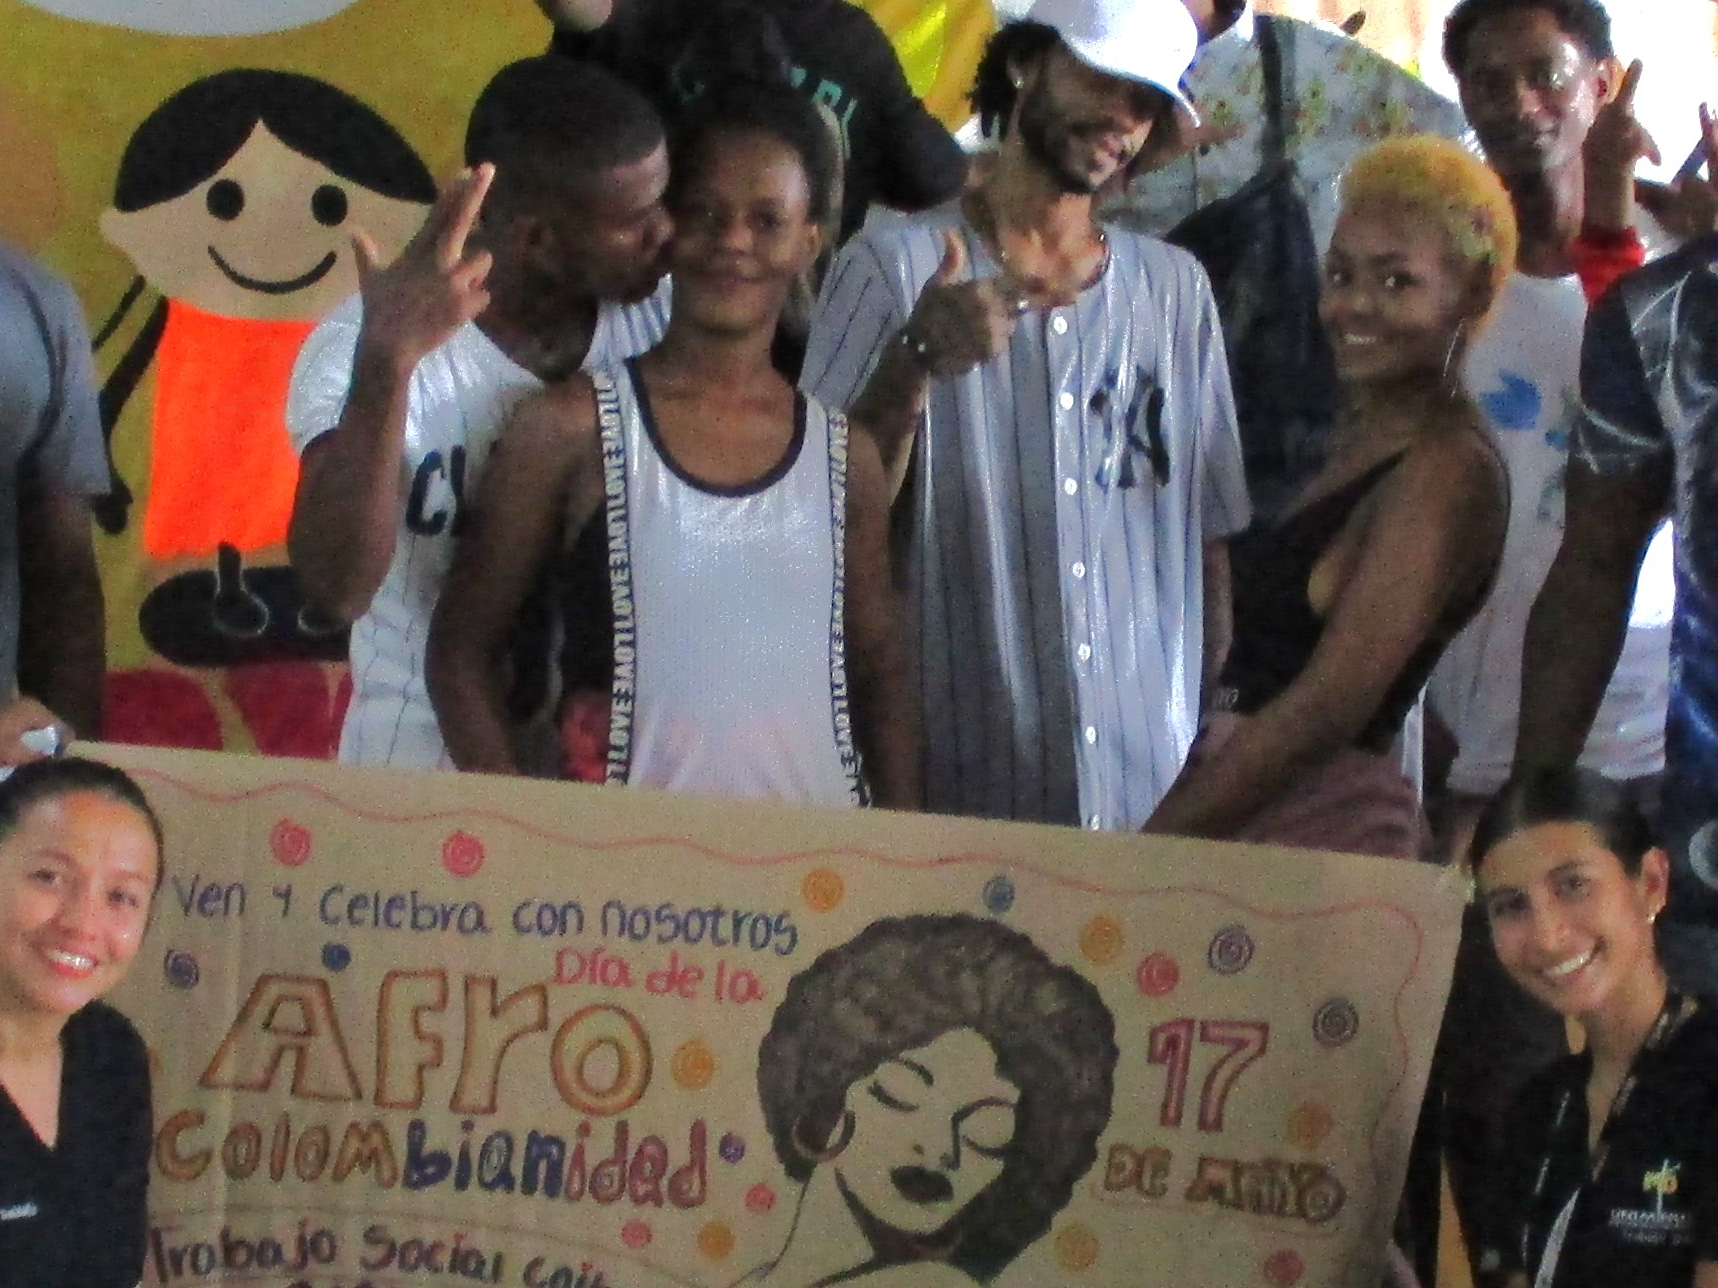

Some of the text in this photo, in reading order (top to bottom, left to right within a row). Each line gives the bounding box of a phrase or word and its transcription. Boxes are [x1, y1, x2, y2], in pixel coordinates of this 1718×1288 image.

[172, 873, 246, 917] Ven
[512, 898, 584, 938] con
[600, 899, 799, 956] nosotros
[645, 950, 705, 1000] de
[715, 959, 767, 1004] la
[1149, 1017, 1269, 1133] 17
[360, 1223, 503, 1285] Social
